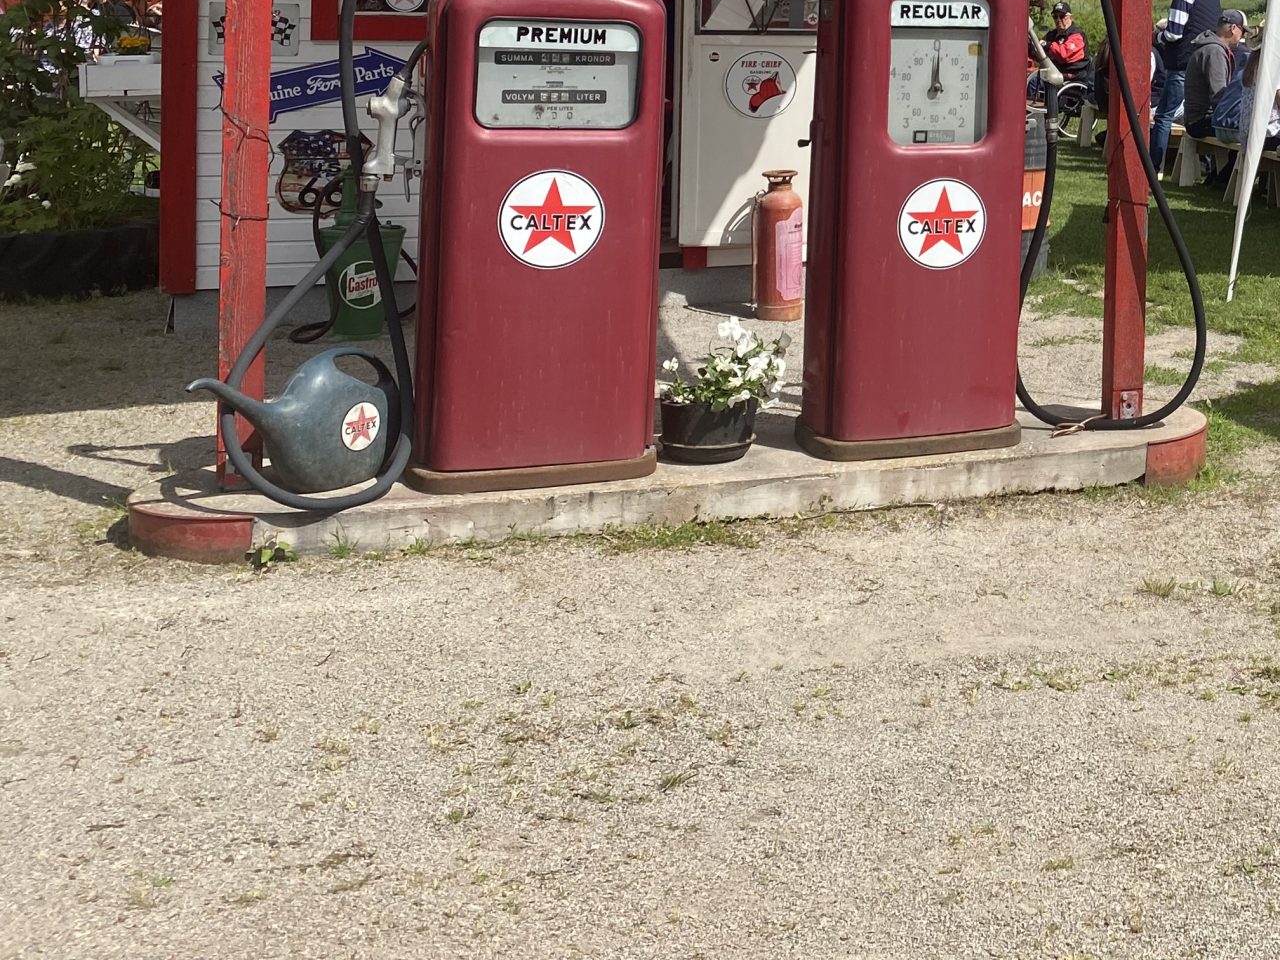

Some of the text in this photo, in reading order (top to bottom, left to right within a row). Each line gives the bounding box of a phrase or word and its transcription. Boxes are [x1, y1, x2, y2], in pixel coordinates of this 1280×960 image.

[900, 5, 982, 20] REGULAR
[516, 26, 607, 44] PREMIUM
[501, 54, 534, 62] SUMMA
[575, 55, 611, 63] KRONOR
[270, 85, 302, 101] uine
[354, 63, 394, 83] Parts
[505, 93, 535, 101] VOLYM
[576, 93, 601, 101] LITER
[299, 178, 342, 207] 66
[510, 214, 592, 232] CALTEX
[907, 217, 977, 236] CALTEX
[348, 276, 378, 293] Castro
[344, 420, 377, 436] CALTEX
